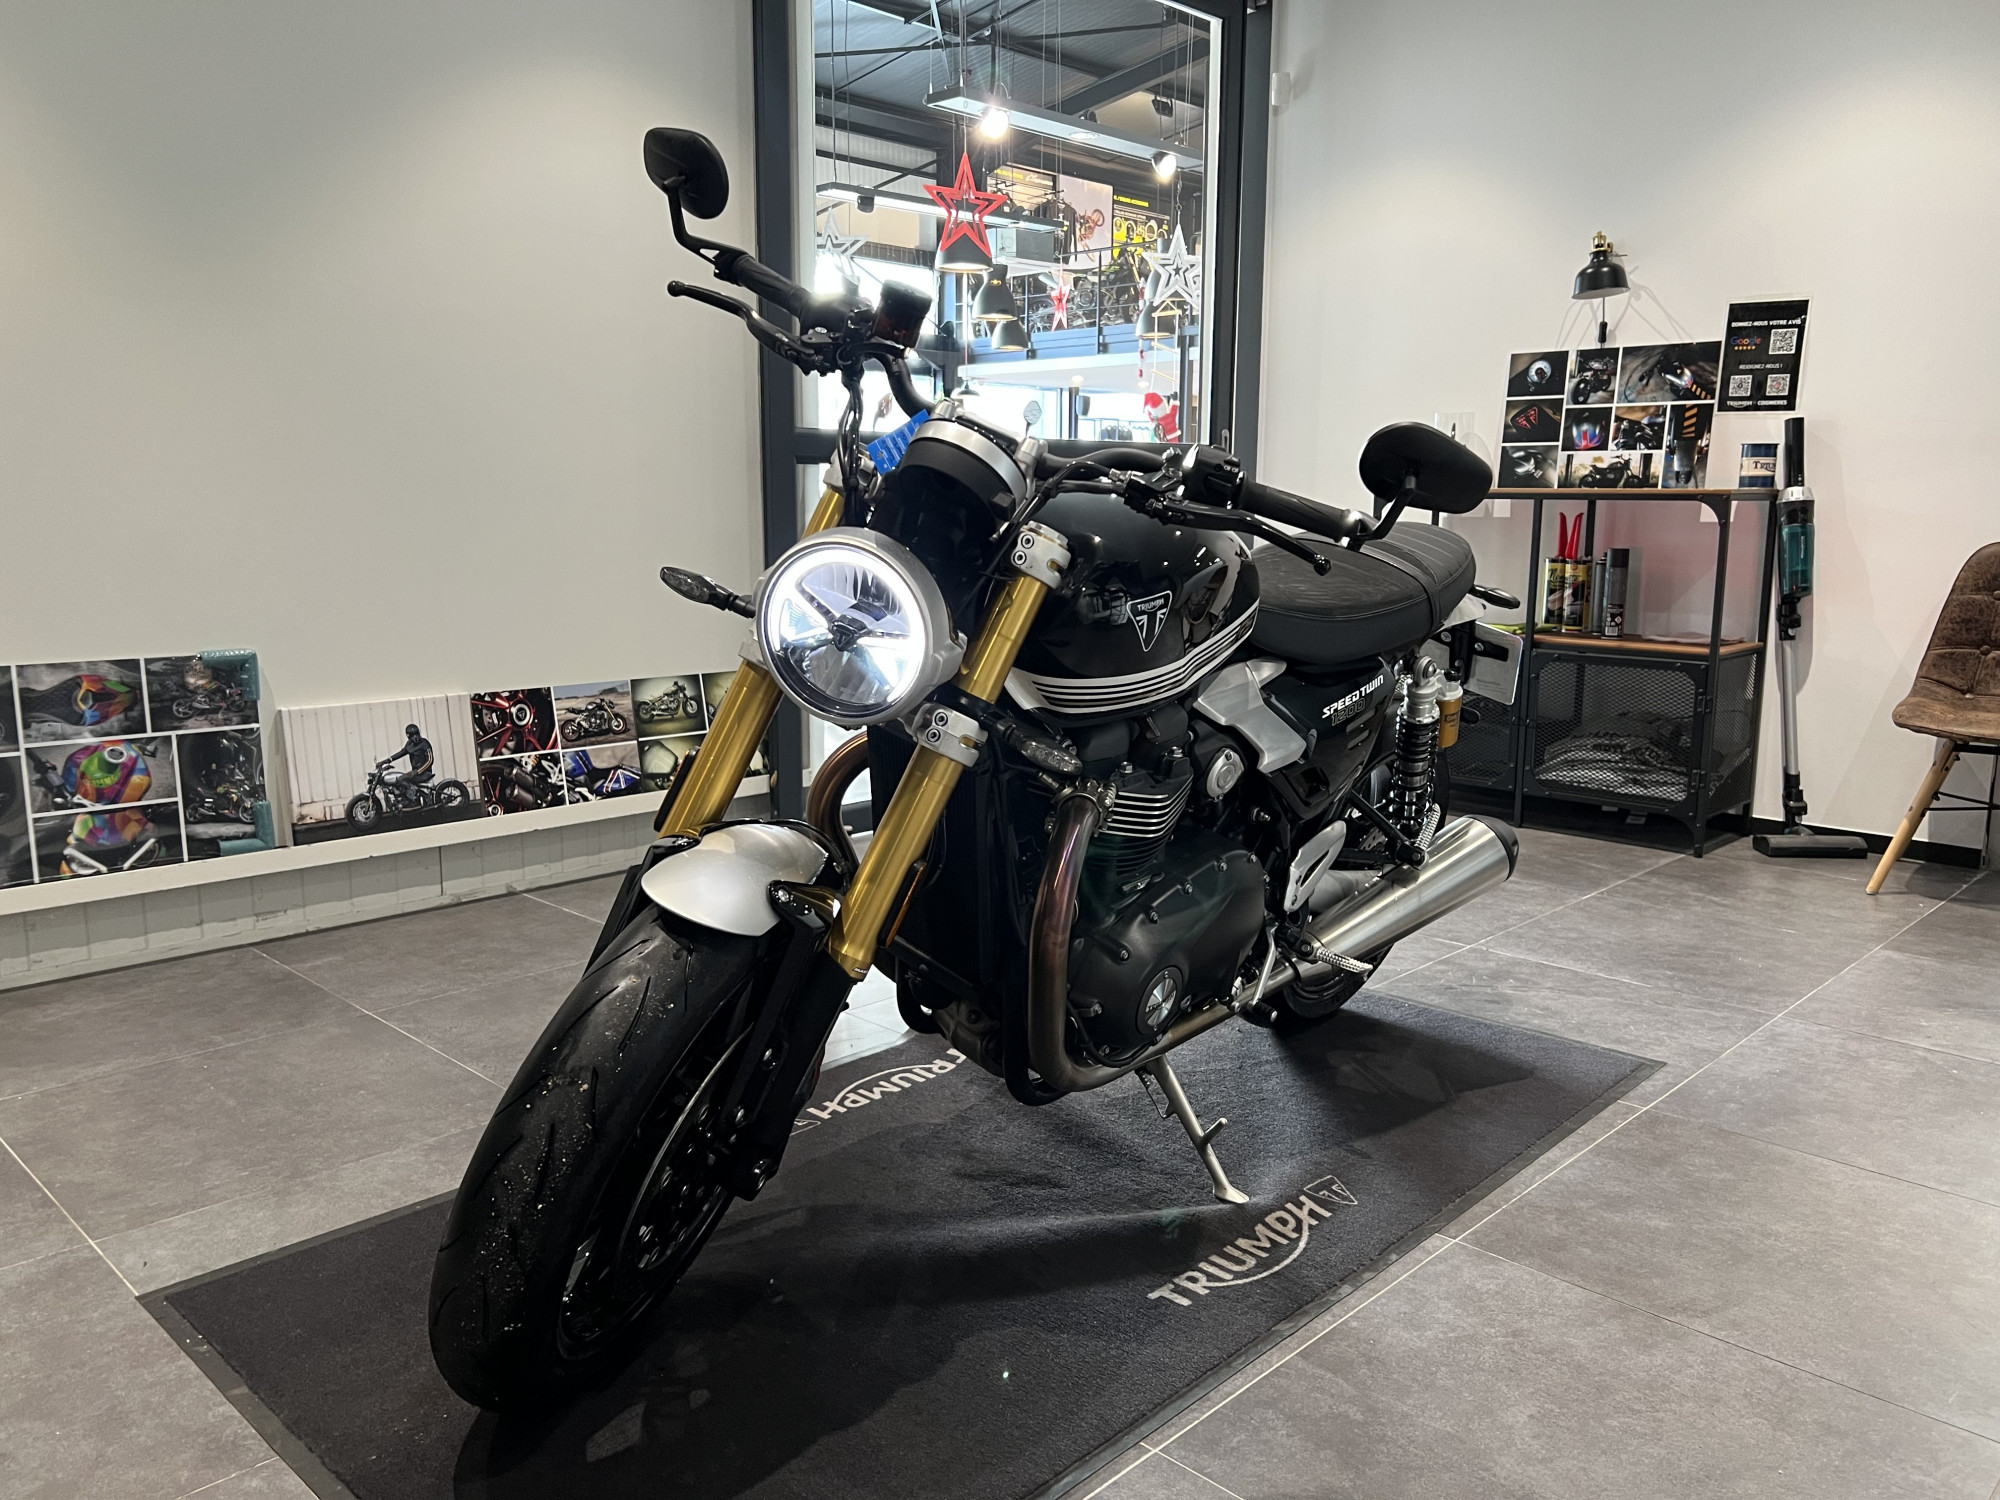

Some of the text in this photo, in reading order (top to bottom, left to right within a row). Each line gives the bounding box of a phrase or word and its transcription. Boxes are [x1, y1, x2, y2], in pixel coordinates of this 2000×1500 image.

[1730, 336, 1762, 346] Google
[1137, 598, 1165, 612] TRIUMPH
[1322, 674, 1384, 719] SPEED TWIN
[1331, 697, 1366, 727] 1200
[1146, 1195, 1333, 1307] TRIUMPH
